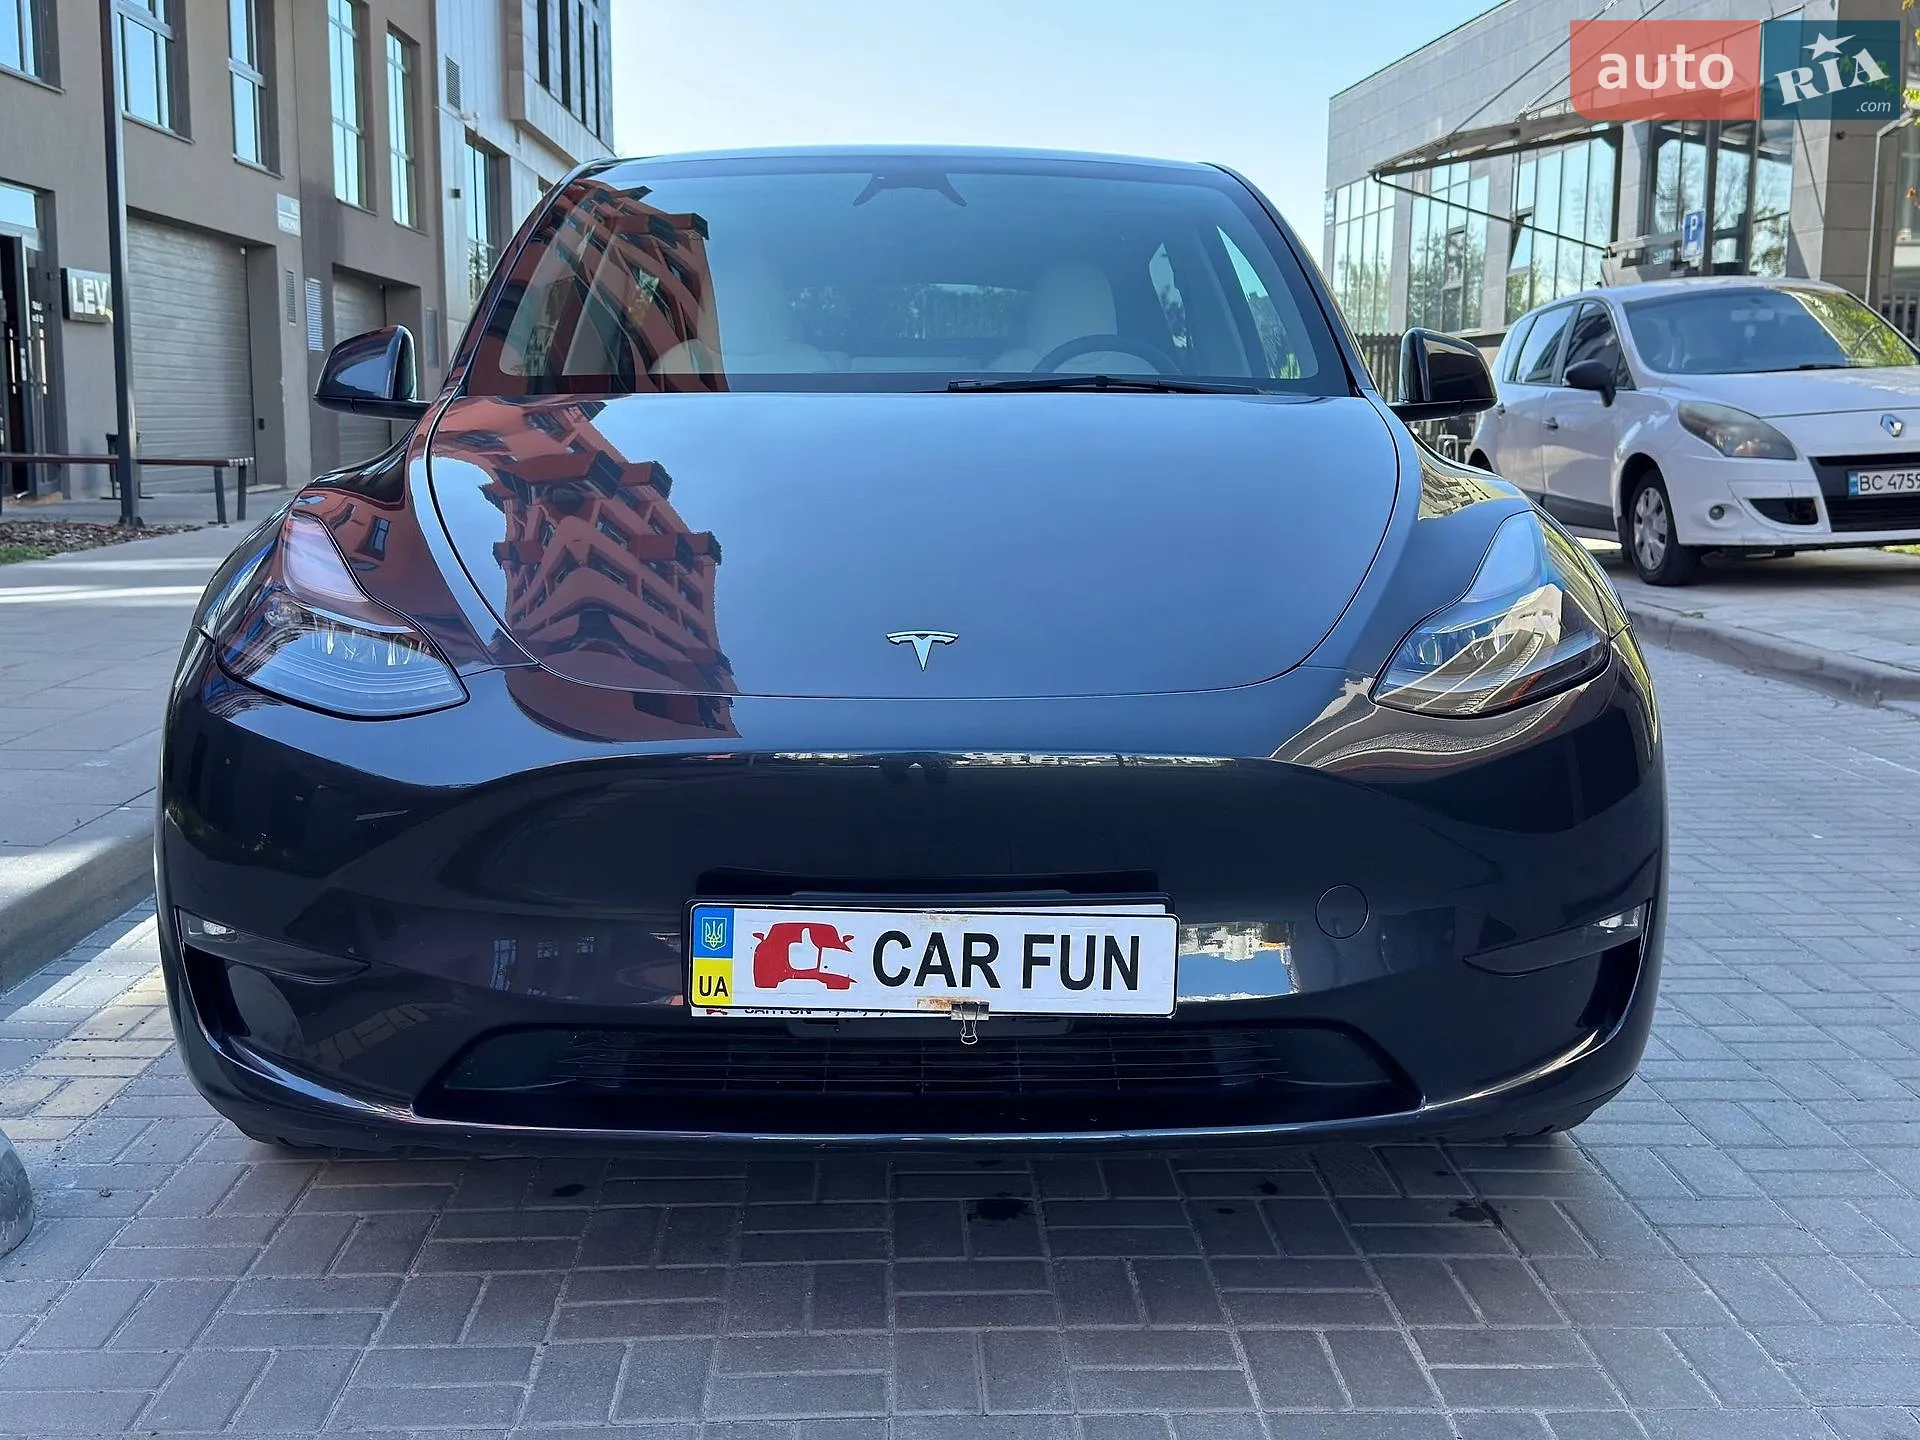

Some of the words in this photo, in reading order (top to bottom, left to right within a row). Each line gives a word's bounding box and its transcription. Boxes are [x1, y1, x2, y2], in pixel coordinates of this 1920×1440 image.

[1689, 214, 1698, 240] P
[71, 276, 108, 316] LEV
[1859, 475, 1883, 492] BC
[872, 930, 1001, 988] CAR
[1022, 933, 1140, 991] FUN
[699, 976, 729, 997] UA
